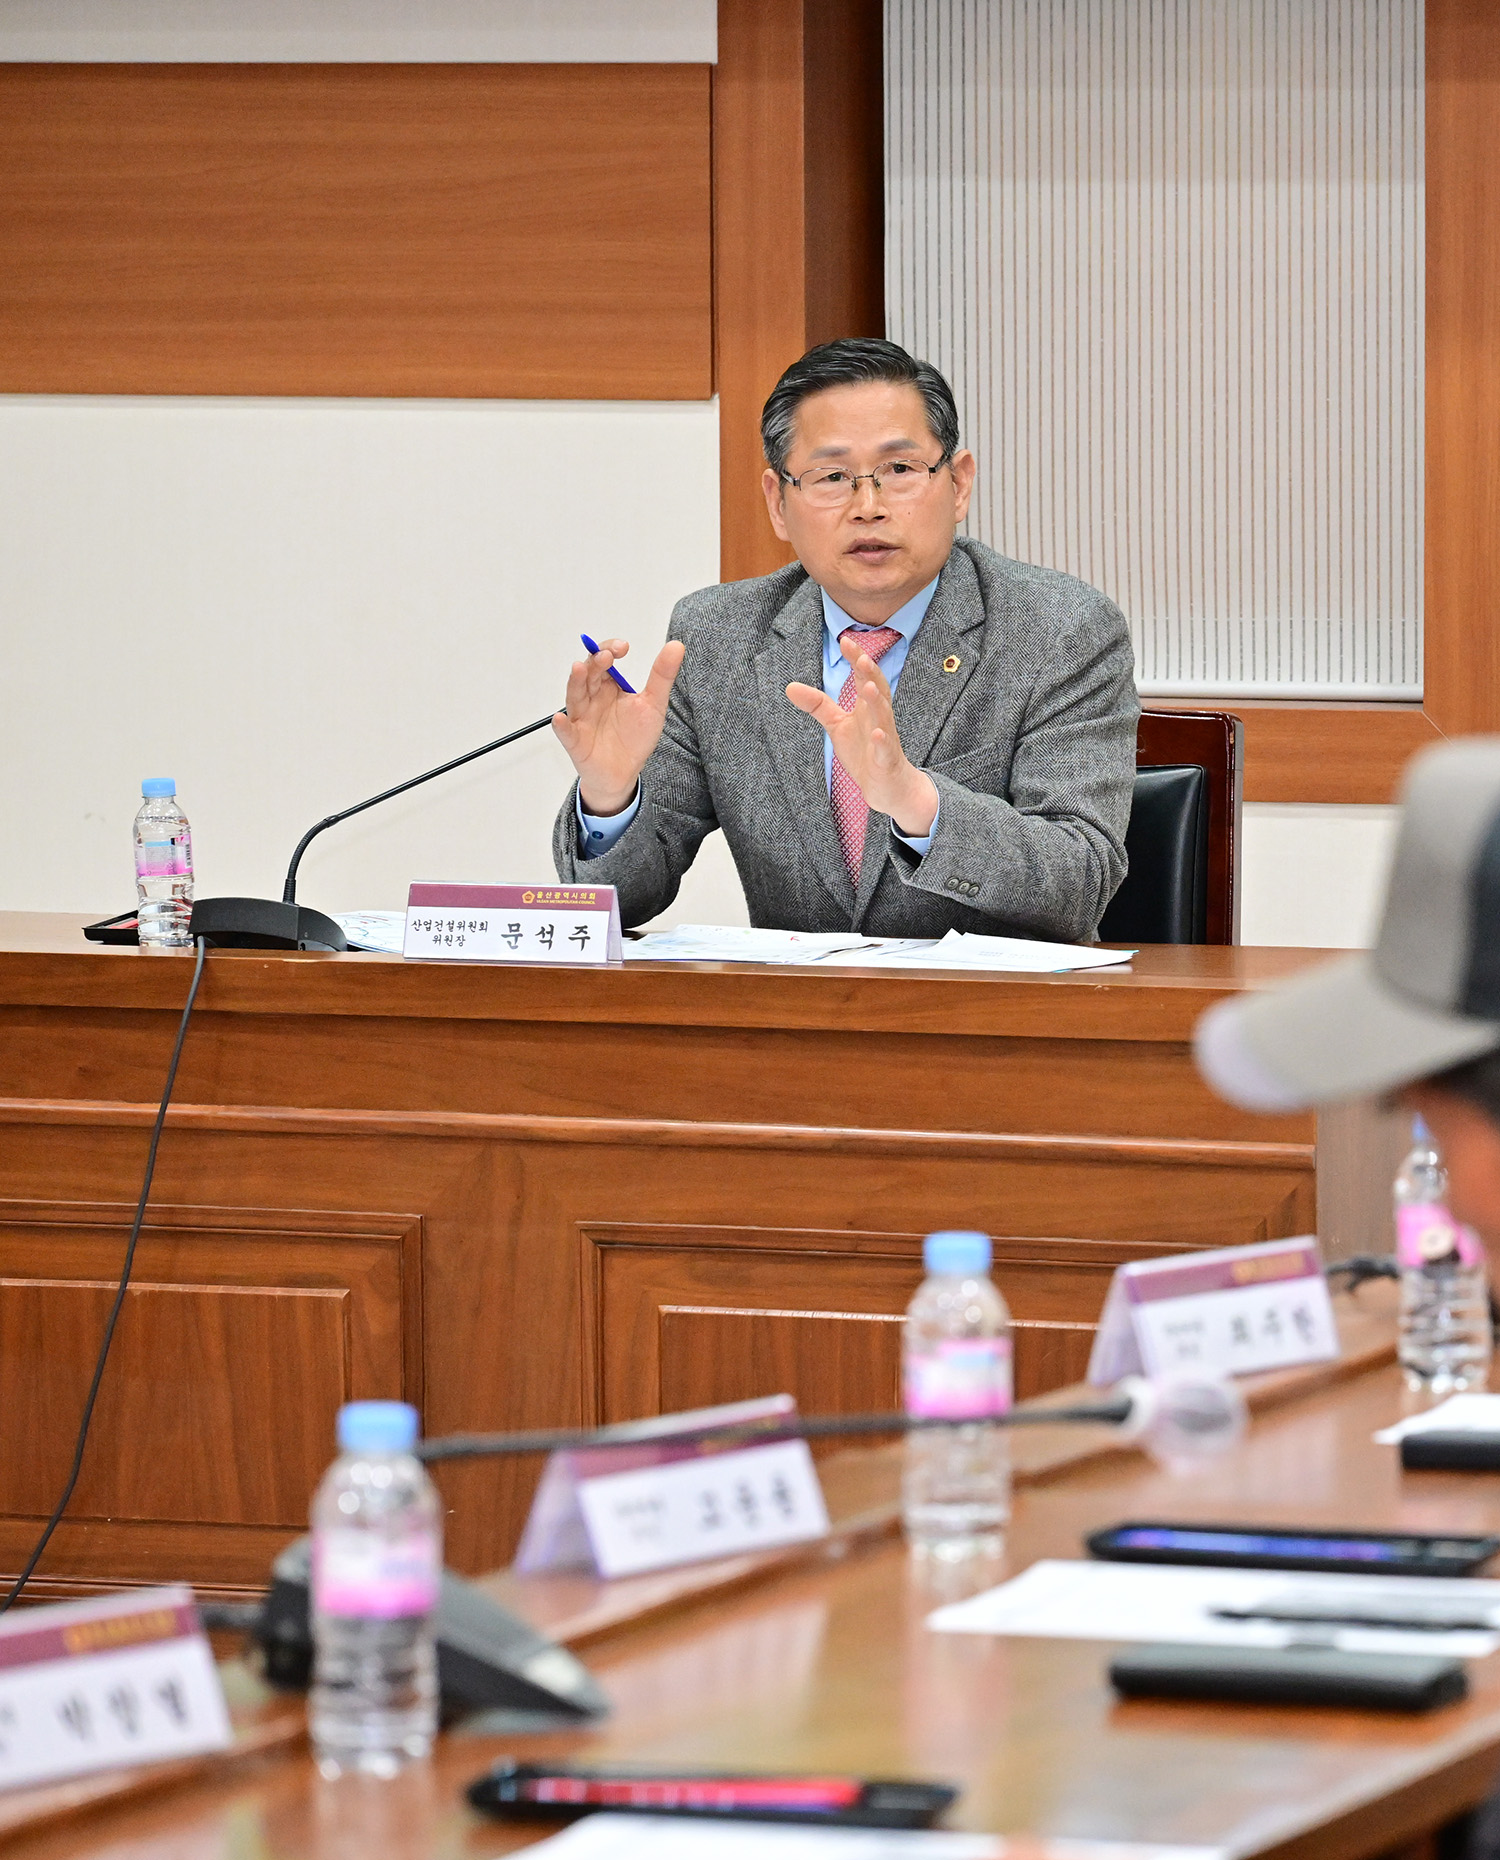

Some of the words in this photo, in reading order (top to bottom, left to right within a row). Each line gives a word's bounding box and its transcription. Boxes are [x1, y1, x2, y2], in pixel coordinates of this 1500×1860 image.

[537, 891, 596, 899] 울산광역시의회
[411, 918, 489, 933] 산업건설위원회
[432, 934, 467, 947] 위원장
